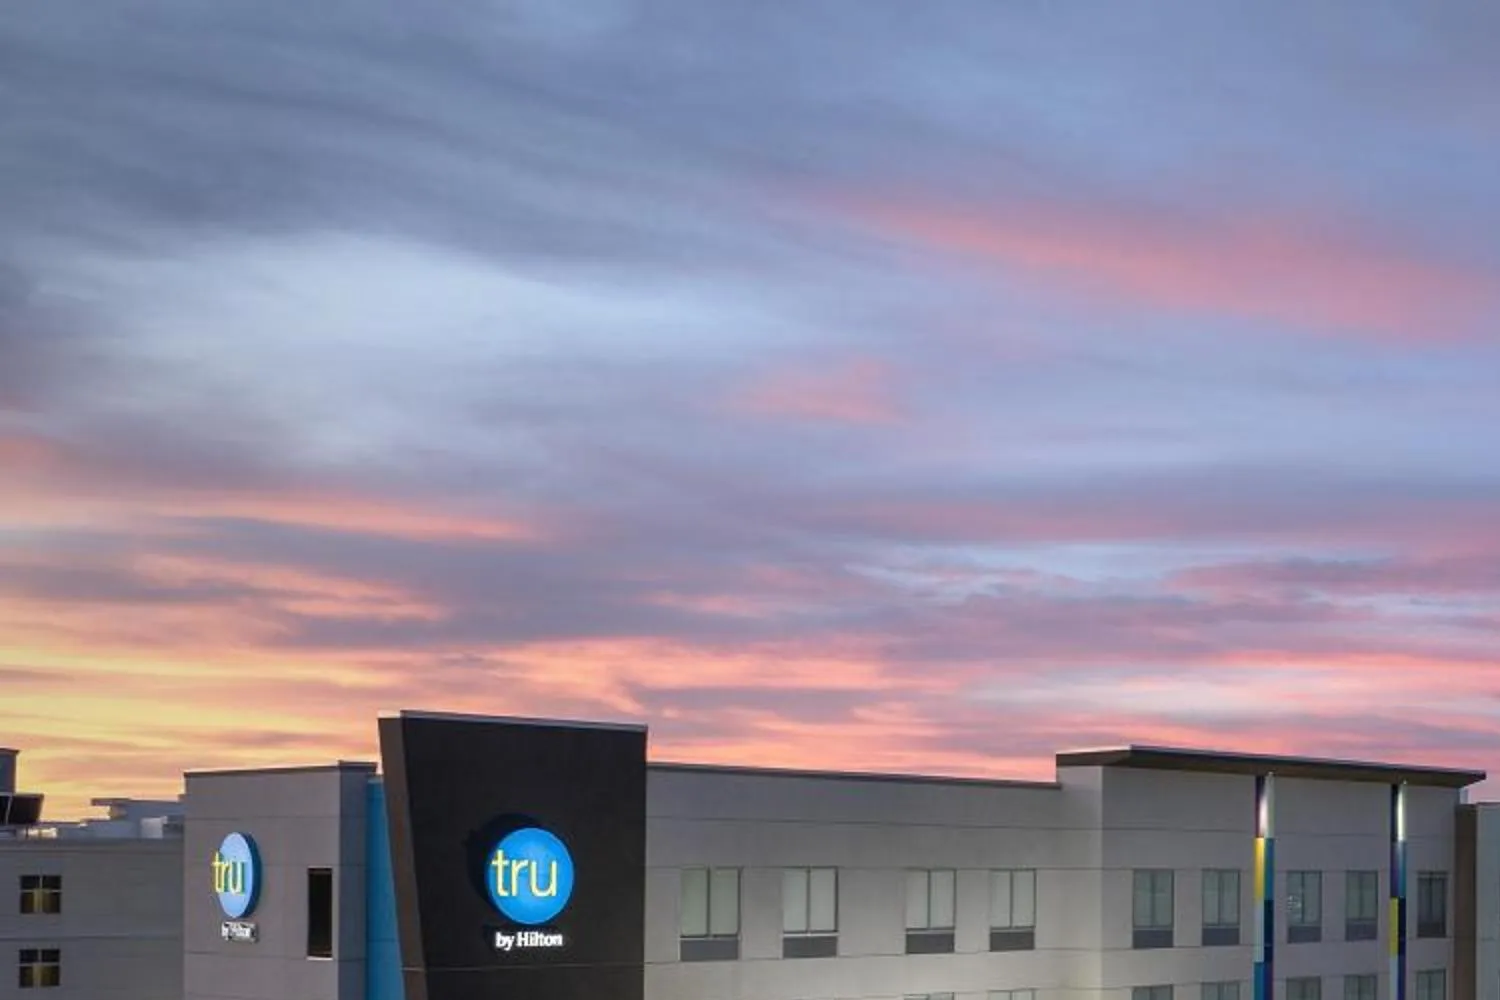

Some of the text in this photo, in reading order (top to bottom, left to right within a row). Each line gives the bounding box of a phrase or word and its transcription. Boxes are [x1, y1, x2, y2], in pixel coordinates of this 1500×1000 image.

[211, 851, 245, 895] tru
[491, 849, 558, 897] tru
[495, 931, 563, 951] by Hilton
